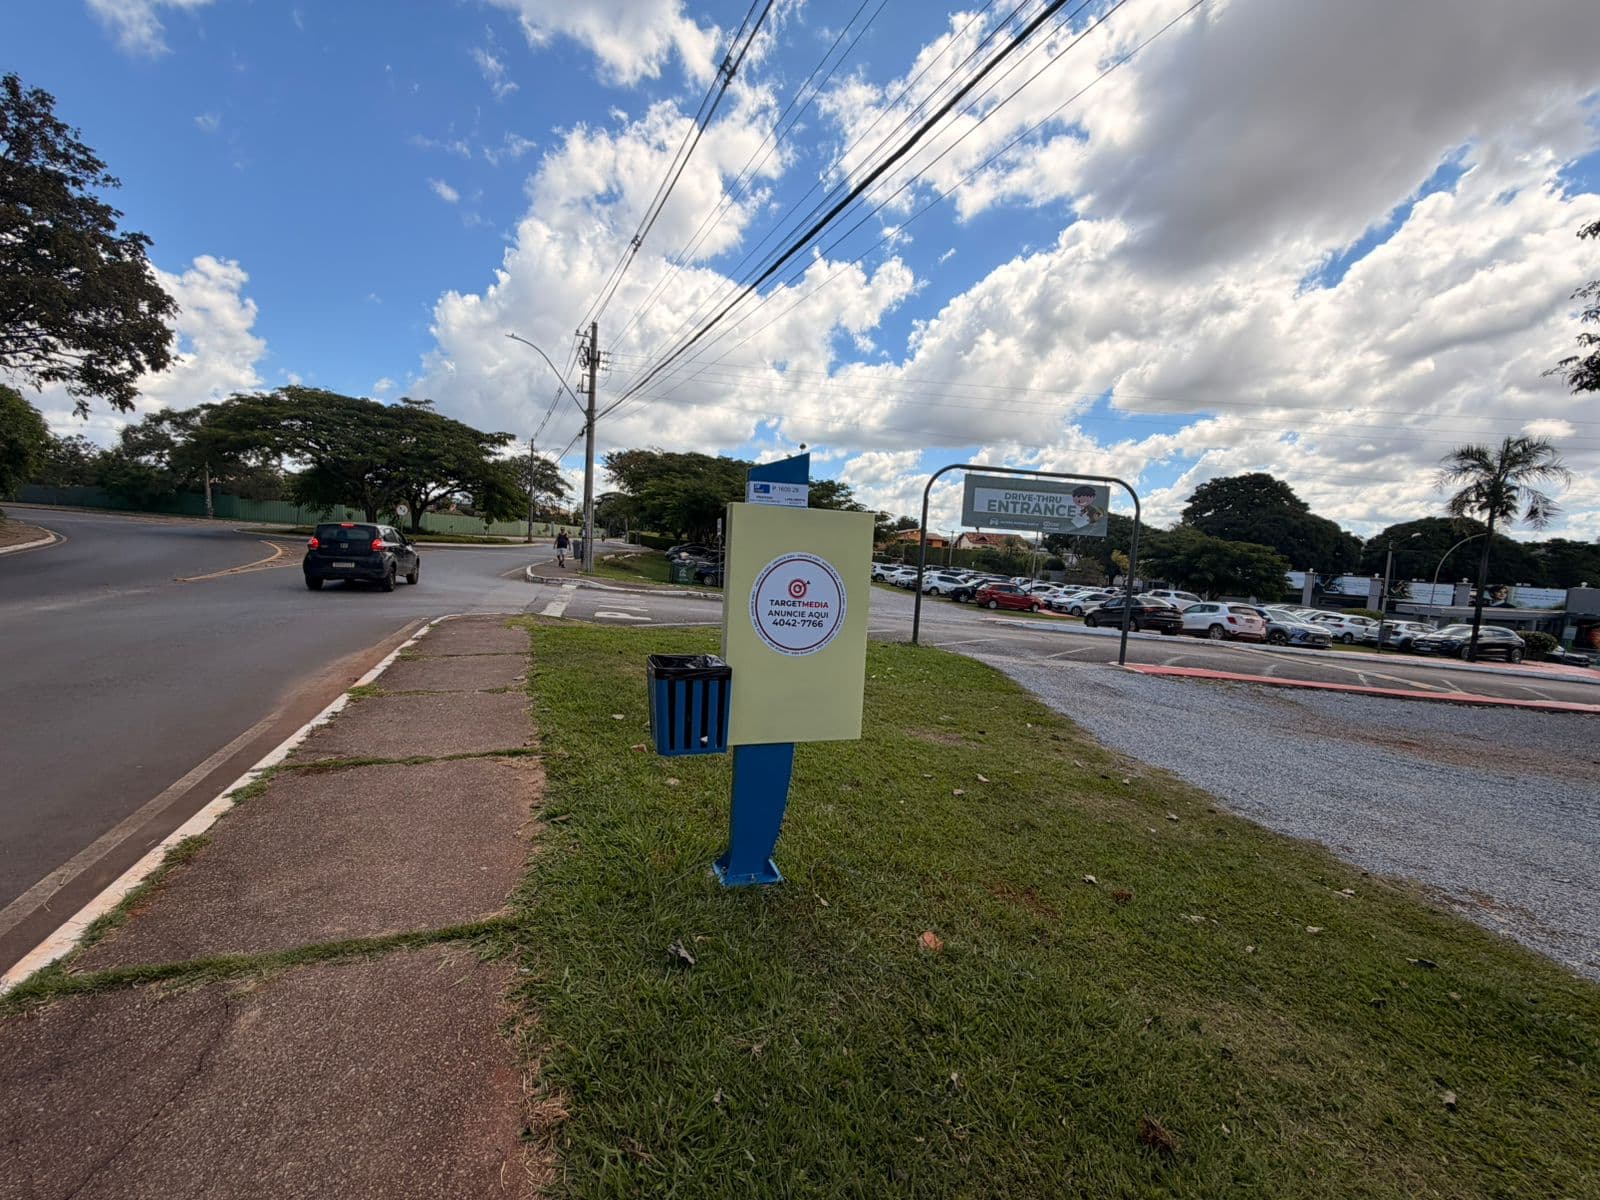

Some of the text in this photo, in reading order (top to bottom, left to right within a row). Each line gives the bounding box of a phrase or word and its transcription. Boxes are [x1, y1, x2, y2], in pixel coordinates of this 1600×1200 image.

[1004, 492, 1062, 503] DRIVE-THRU
[987, 499, 1076, 517] ENTRANCE
[769, 599, 829, 608] TARGETMEDIA
[768, 610, 829, 619] ANUNCIE AQUI
[772, 619, 824, 628] 4042-7766
